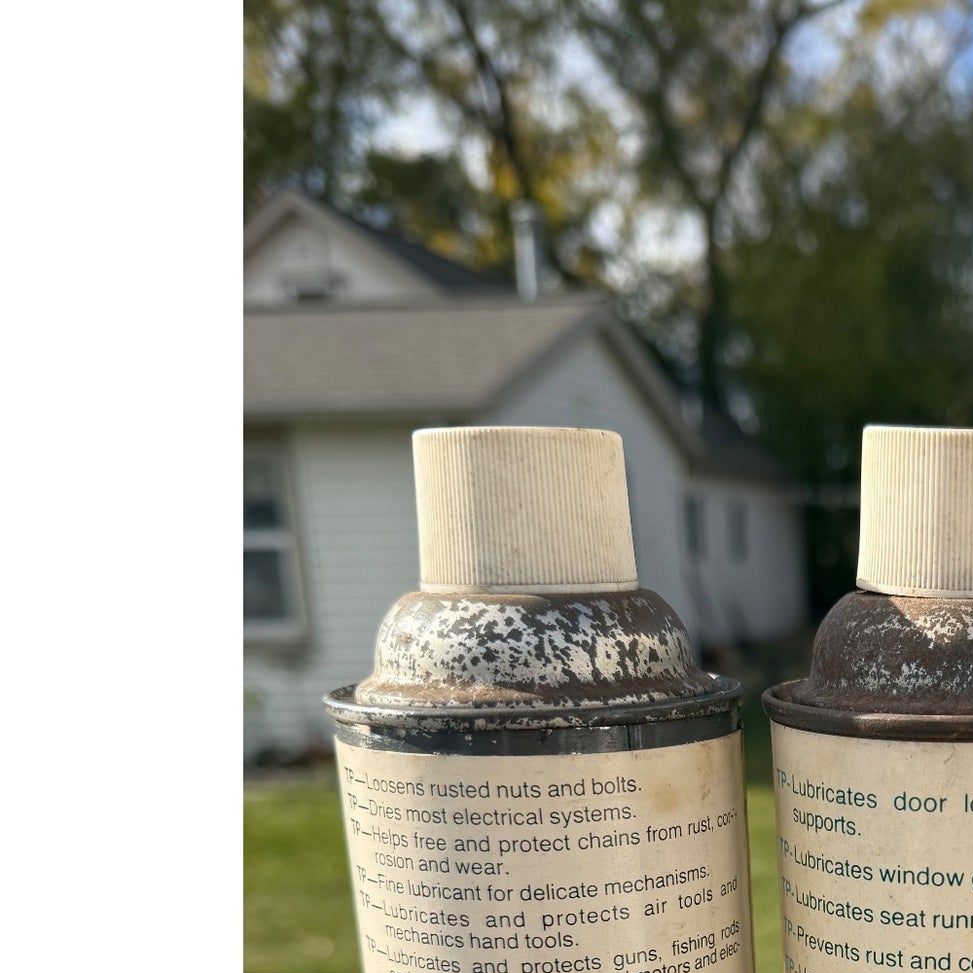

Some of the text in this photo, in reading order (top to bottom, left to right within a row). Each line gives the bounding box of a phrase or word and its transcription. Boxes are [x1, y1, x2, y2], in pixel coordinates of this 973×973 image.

[345, 767, 642, 798] TP—Loosens rusted nuts and bolts.
[777, 768, 877, 809] TP-Lubricates
[894, 791, 947, 812] door
[793, 808, 861, 835] supports.
[357, 865, 710, 901] TP—Fine lubricant for delicate mechanisms.
[780, 837, 873, 881] TP-Lubricates
[879, 865, 964, 886] window
[360, 890, 469, 926] TP—Lubricates
[486, 912, 525, 927] and
[543, 906, 629, 930] protects
[644, 899, 667, 916] air
[678, 888, 713, 909] tools
[781, 876, 874, 923] TP-Lubricates
[880, 910, 925, 928] seat
[784, 916, 859, 962] TP-Prevents
[866, 950, 903, 968] rust
[910, 952, 950, 970] and
